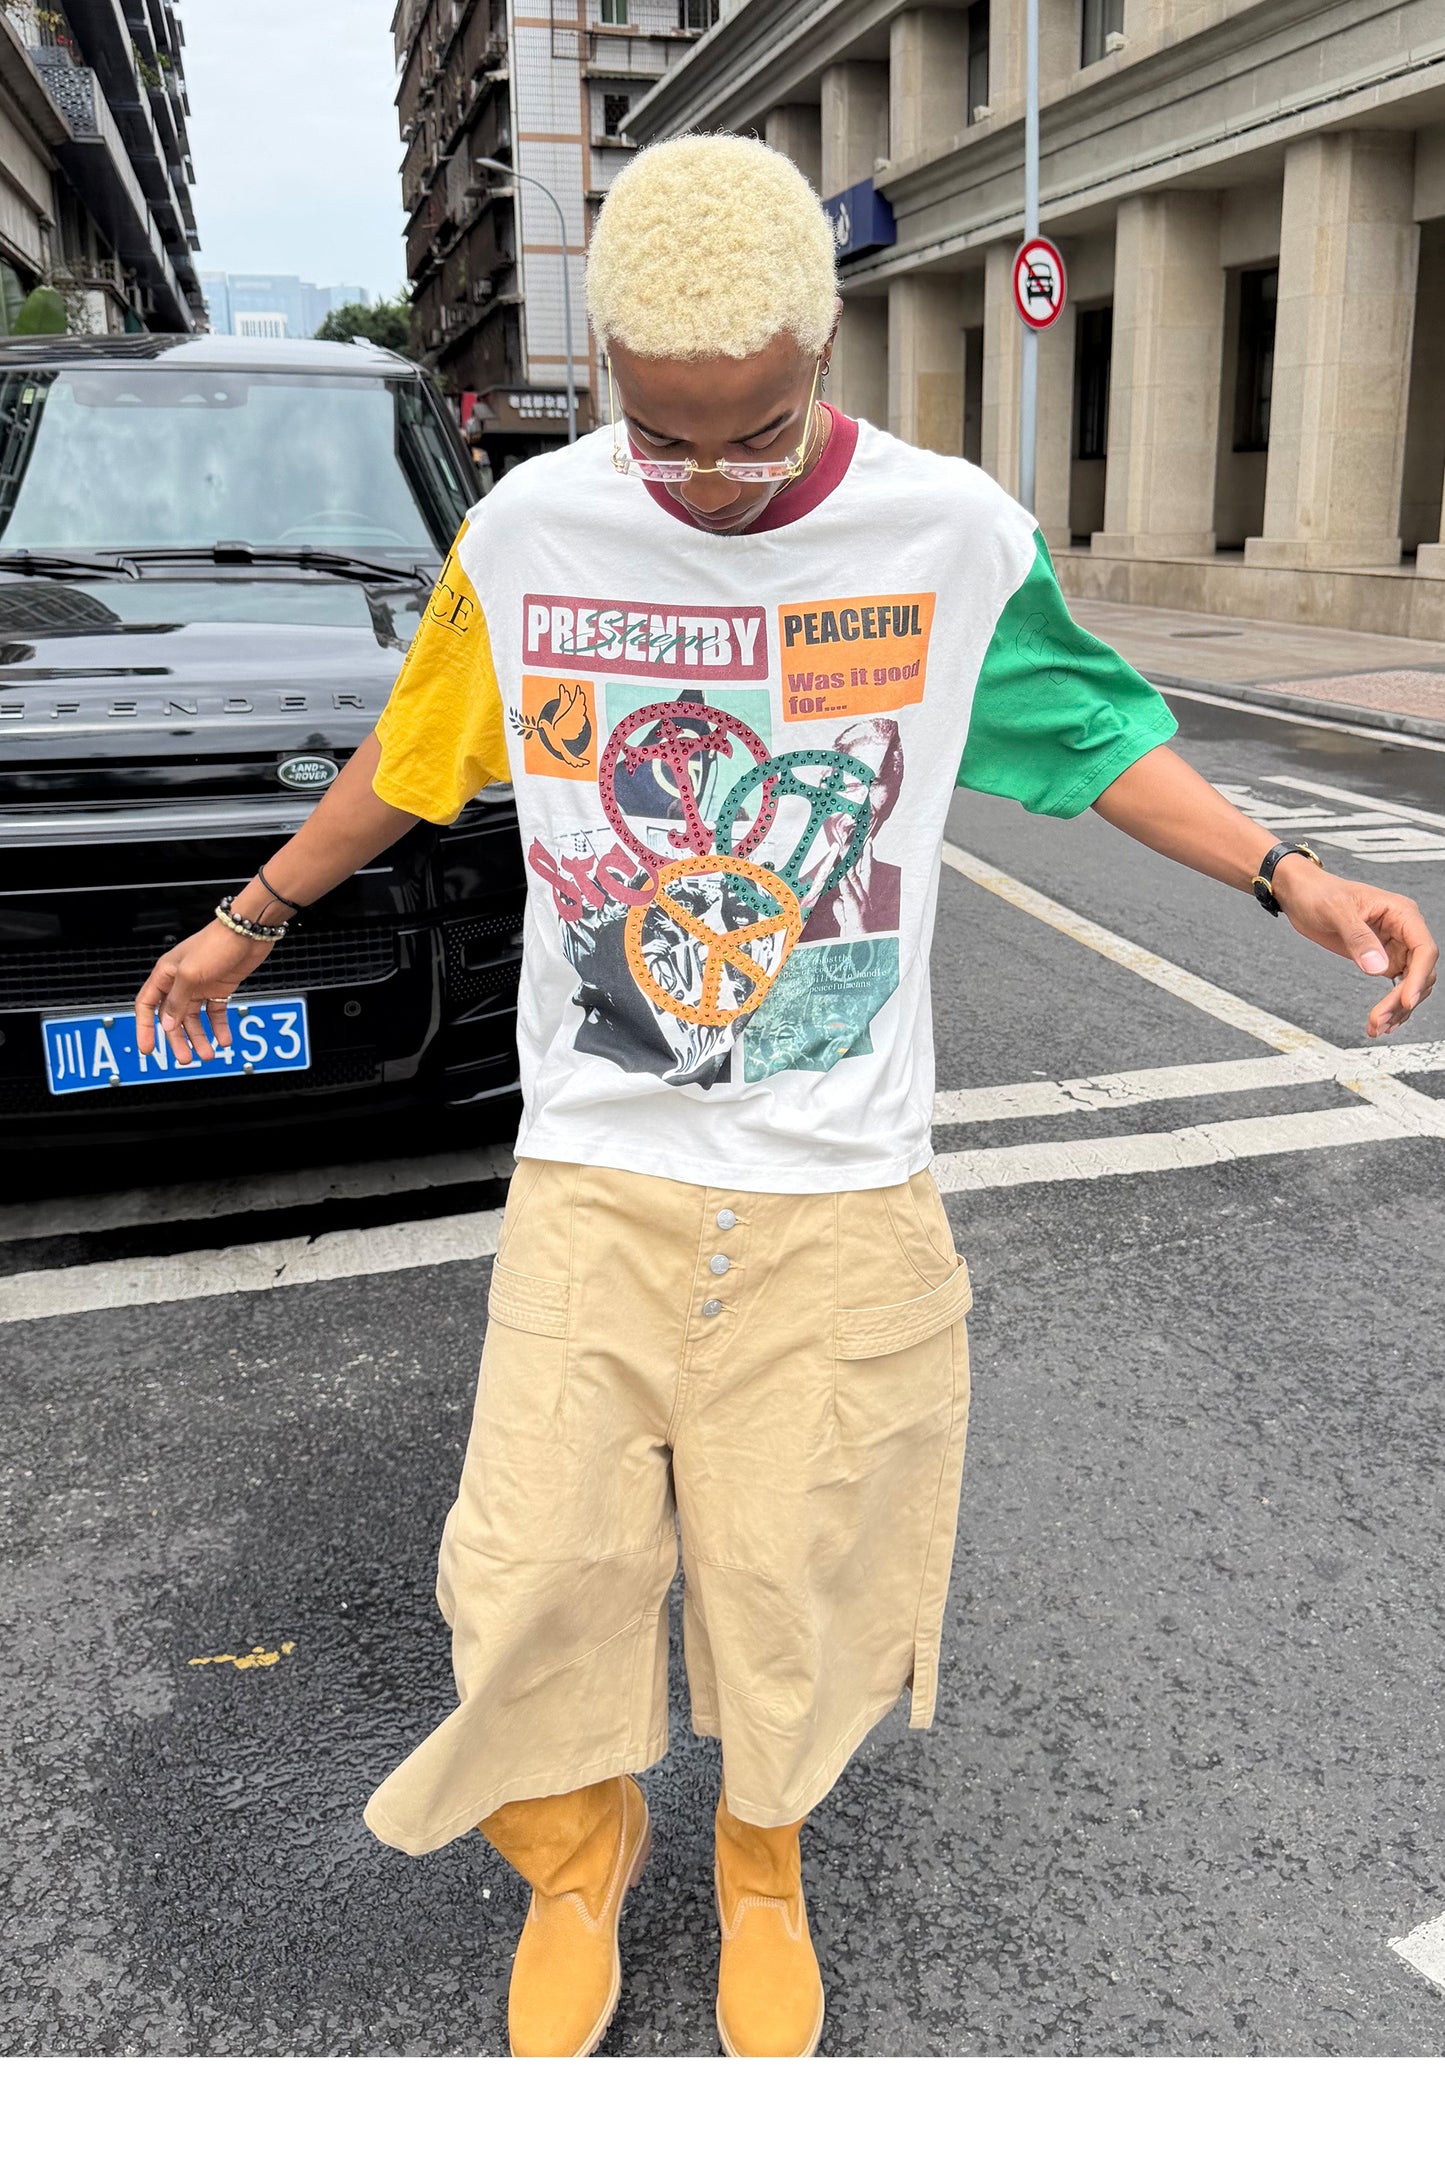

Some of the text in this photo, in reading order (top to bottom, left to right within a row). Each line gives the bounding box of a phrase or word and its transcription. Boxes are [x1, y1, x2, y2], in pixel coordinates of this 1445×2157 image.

[784, 604, 922, 648] PEACEFUL
[788, 659, 921, 693] Was it good
[291, 762, 319, 773] LAND
[294, 770, 328, 781] ROVER
